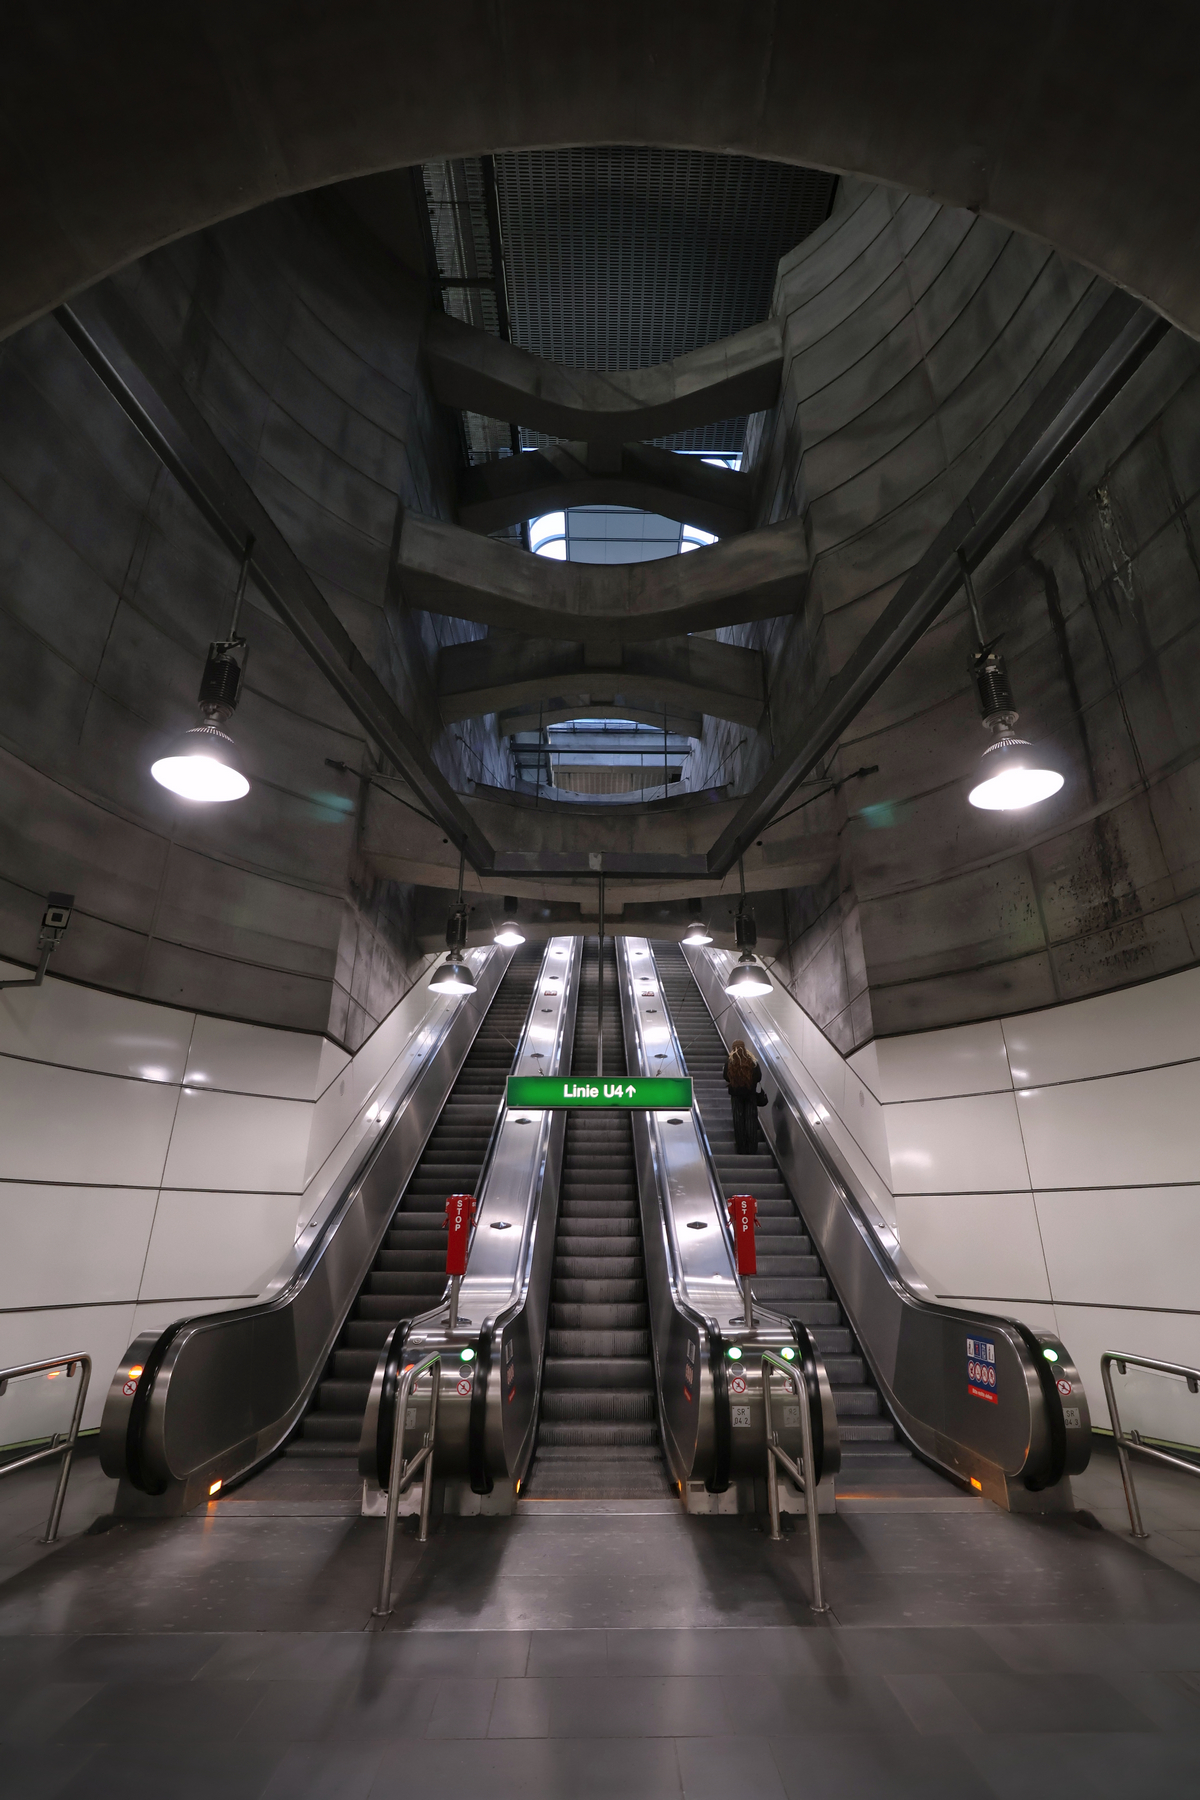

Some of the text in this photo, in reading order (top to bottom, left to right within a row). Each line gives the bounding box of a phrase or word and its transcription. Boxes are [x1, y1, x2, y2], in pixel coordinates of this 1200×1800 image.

[564, 1084, 623, 1098] Linie U4
[455, 1200, 463, 1231] STOP
[741, 1201, 749, 1232] STOP
